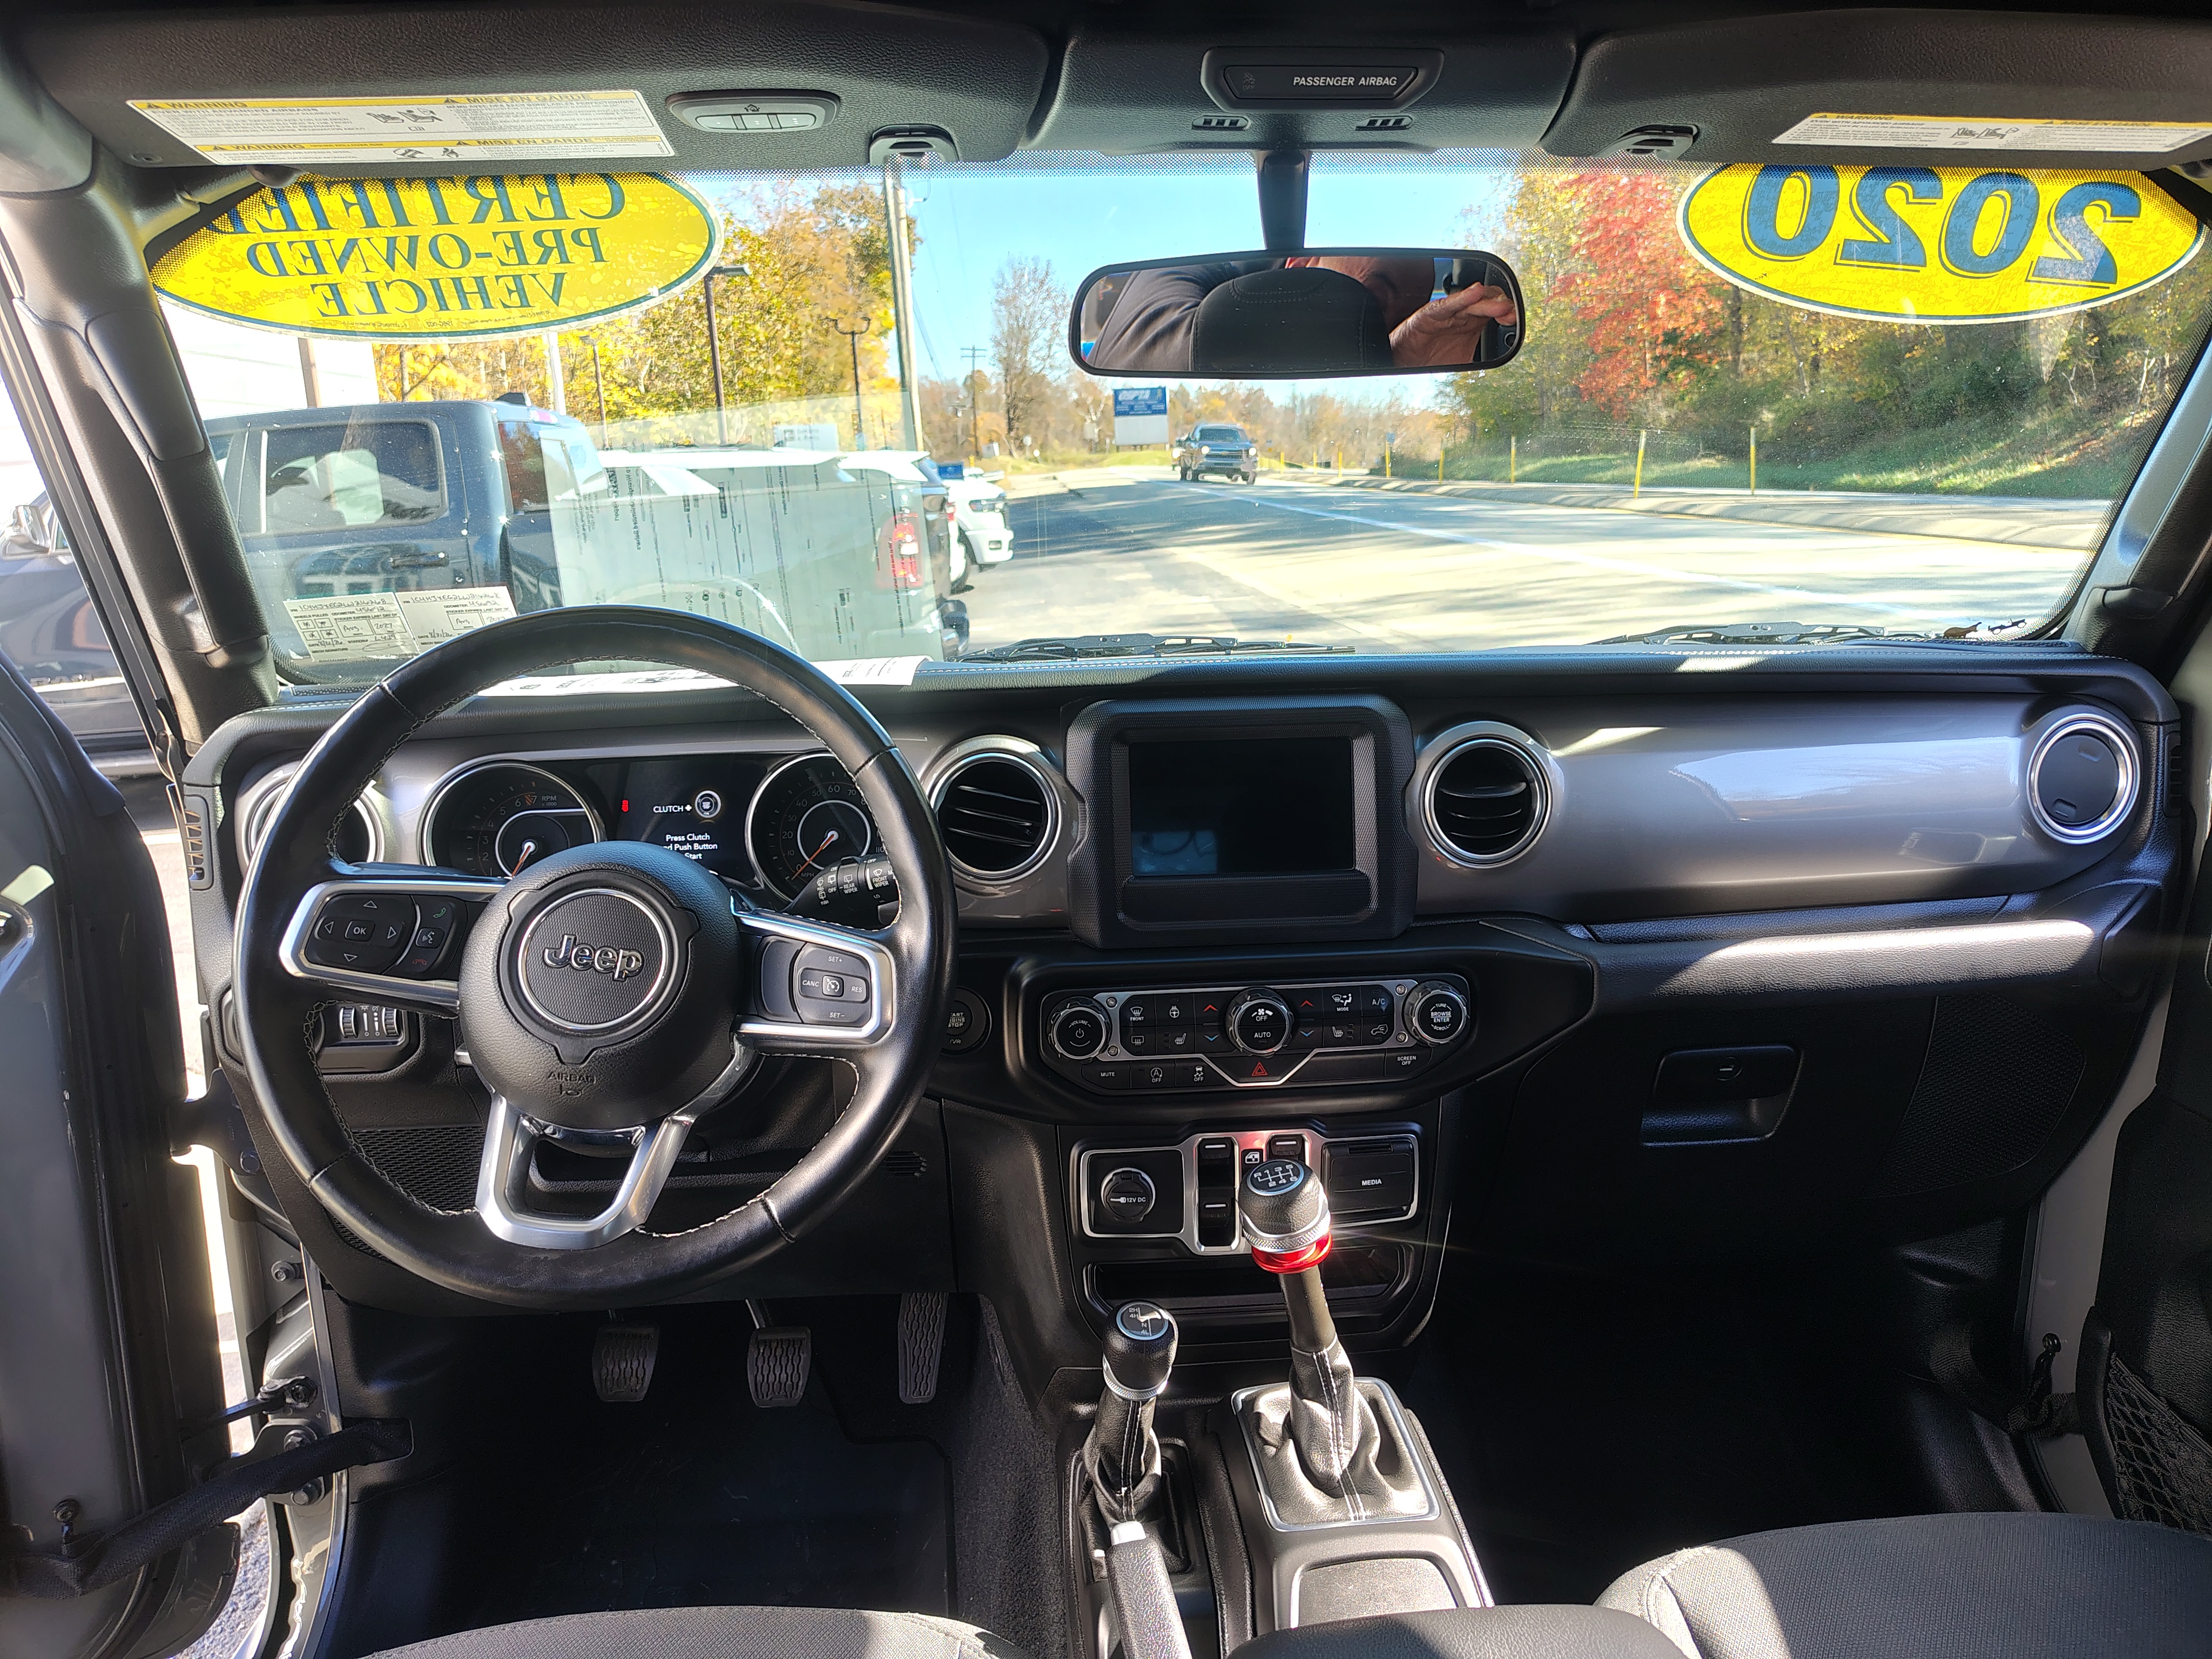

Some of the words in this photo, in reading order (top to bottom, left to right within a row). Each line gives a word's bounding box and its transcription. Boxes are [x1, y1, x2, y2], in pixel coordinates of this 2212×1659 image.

[1293, 77, 1355, 87] PASSENGER
[1358, 77, 1398, 87] AIRBAG
[827, 785, 840, 793] 60
[515, 799, 522, 807] 6
[500, 807, 507, 815] 5
[653, 805, 684, 813] CLUTCH
[488, 820, 495, 828] 4
[686, 832, 710, 841] Clutch
[782, 831, 793, 839] 20
[482, 835, 489, 845] 3
[675, 842, 692, 851] Push
[482, 853, 489, 861] 2
[872, 875, 887, 884] FRONT
[353, 927, 367, 935] OK
[544, 934, 644, 982] Jeep
[802, 979, 819, 988] CANC
